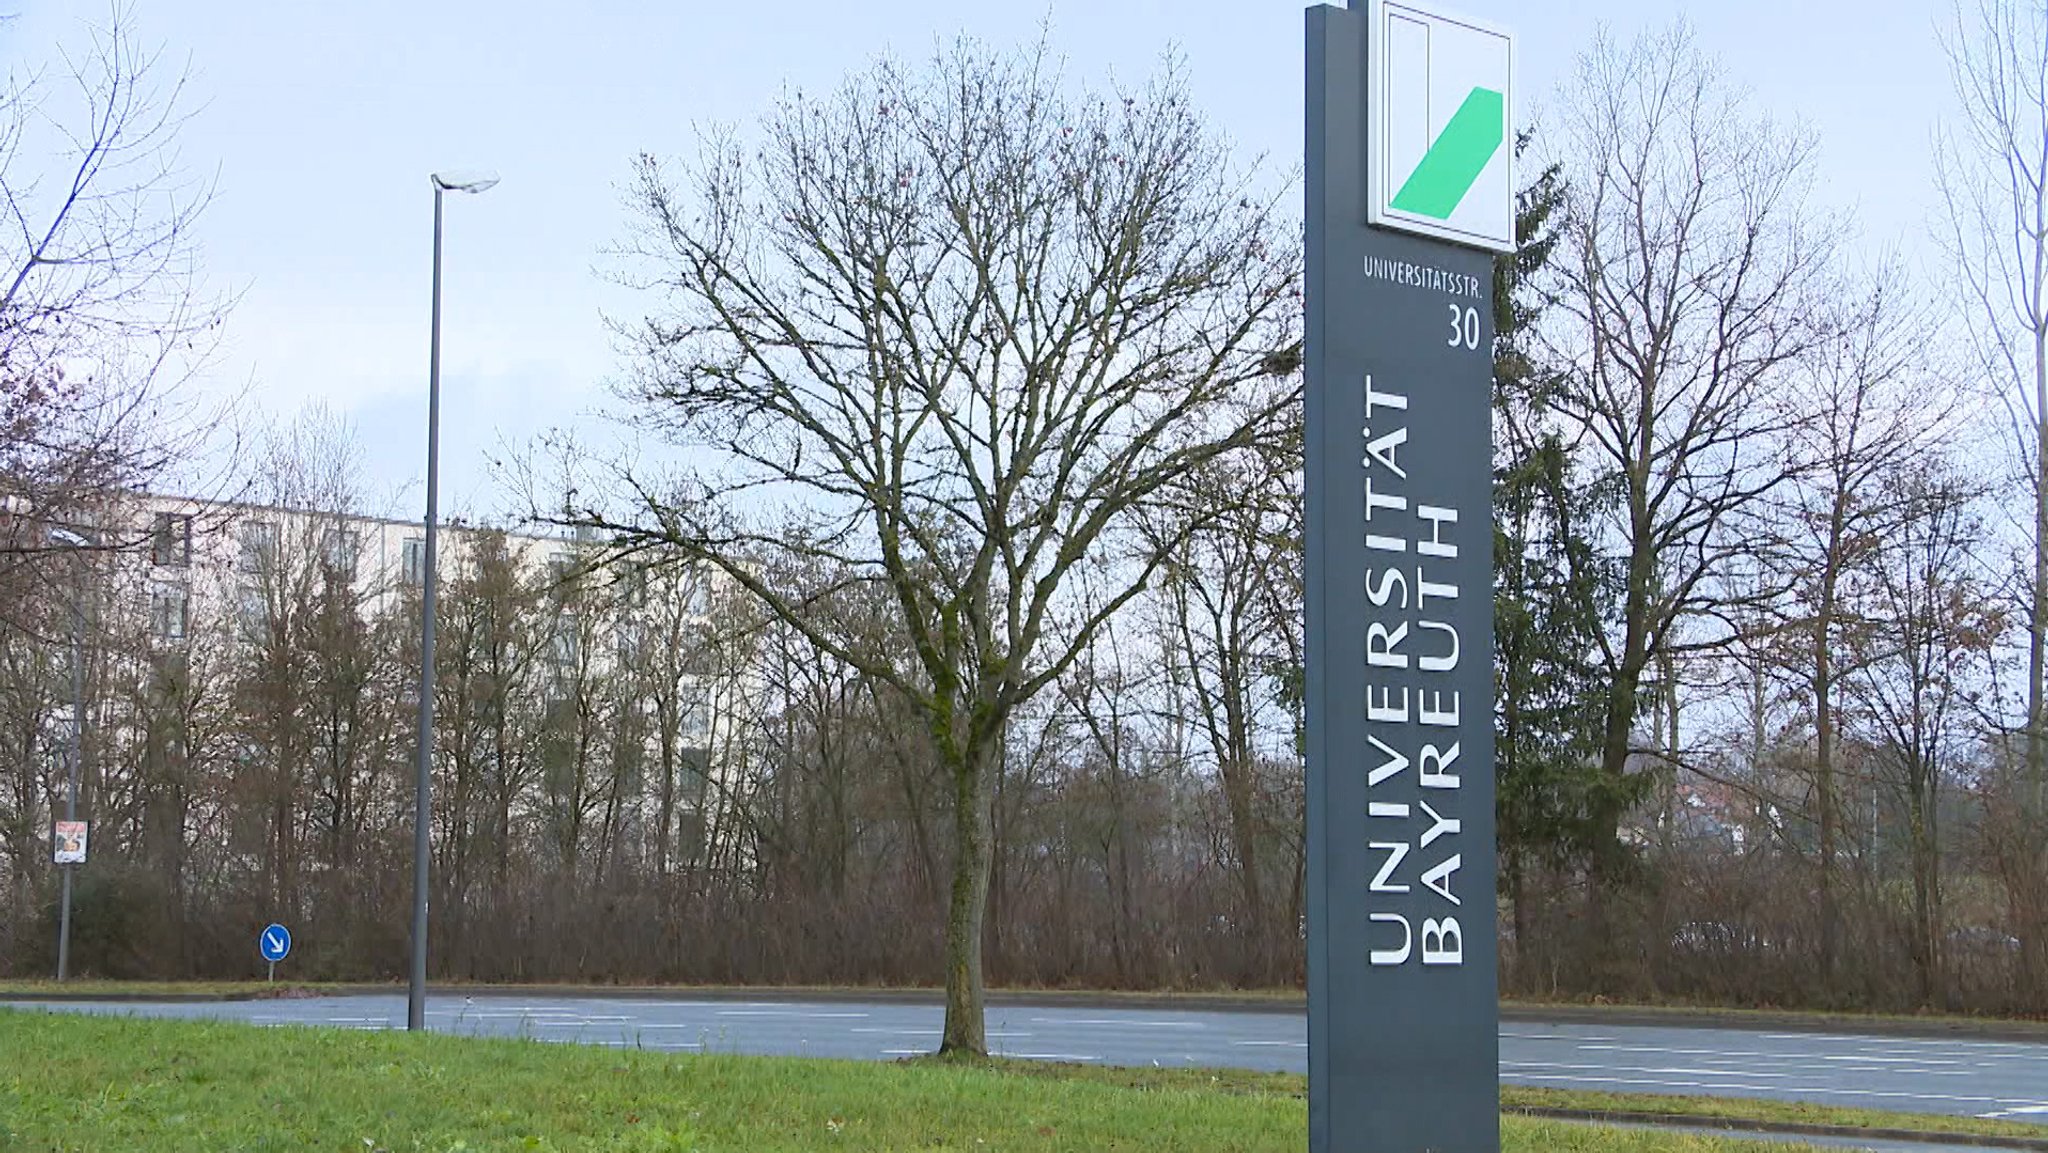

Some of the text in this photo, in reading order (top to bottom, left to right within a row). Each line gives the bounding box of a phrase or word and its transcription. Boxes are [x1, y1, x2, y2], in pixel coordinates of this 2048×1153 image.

[1363, 255, 1483, 299] UNIVERSITÄTSSTR.
[1447, 303, 1480, 351] 30
[1363, 374, 1412, 964] UNIVERSITÄT
[1416, 504, 1463, 966] BAYREUTH
